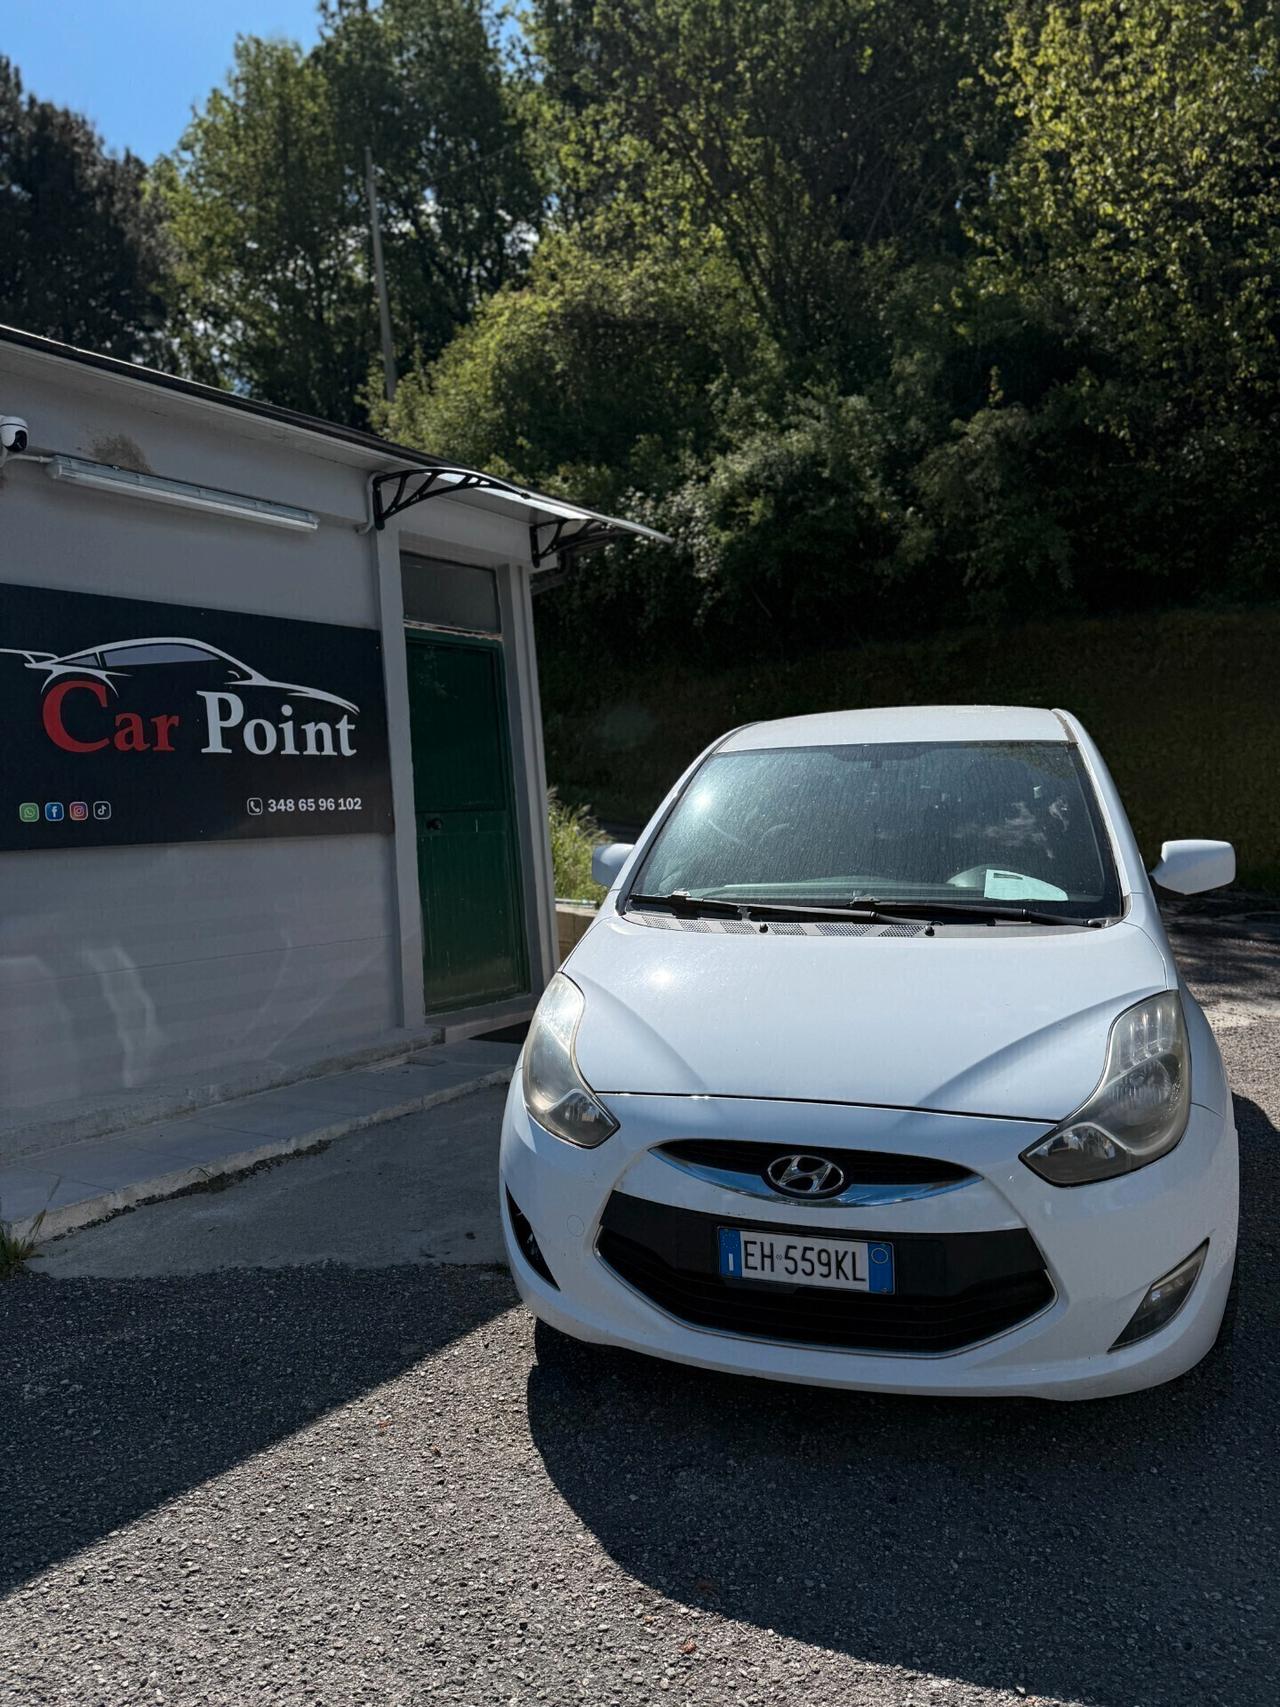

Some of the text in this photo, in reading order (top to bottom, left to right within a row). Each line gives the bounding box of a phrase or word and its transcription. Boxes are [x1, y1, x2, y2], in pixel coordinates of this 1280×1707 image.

[42, 680, 357, 757] Car Point
[267, 797, 362, 812] 348 65 96 102
[743, 1240, 867, 1282] EH 559KL
